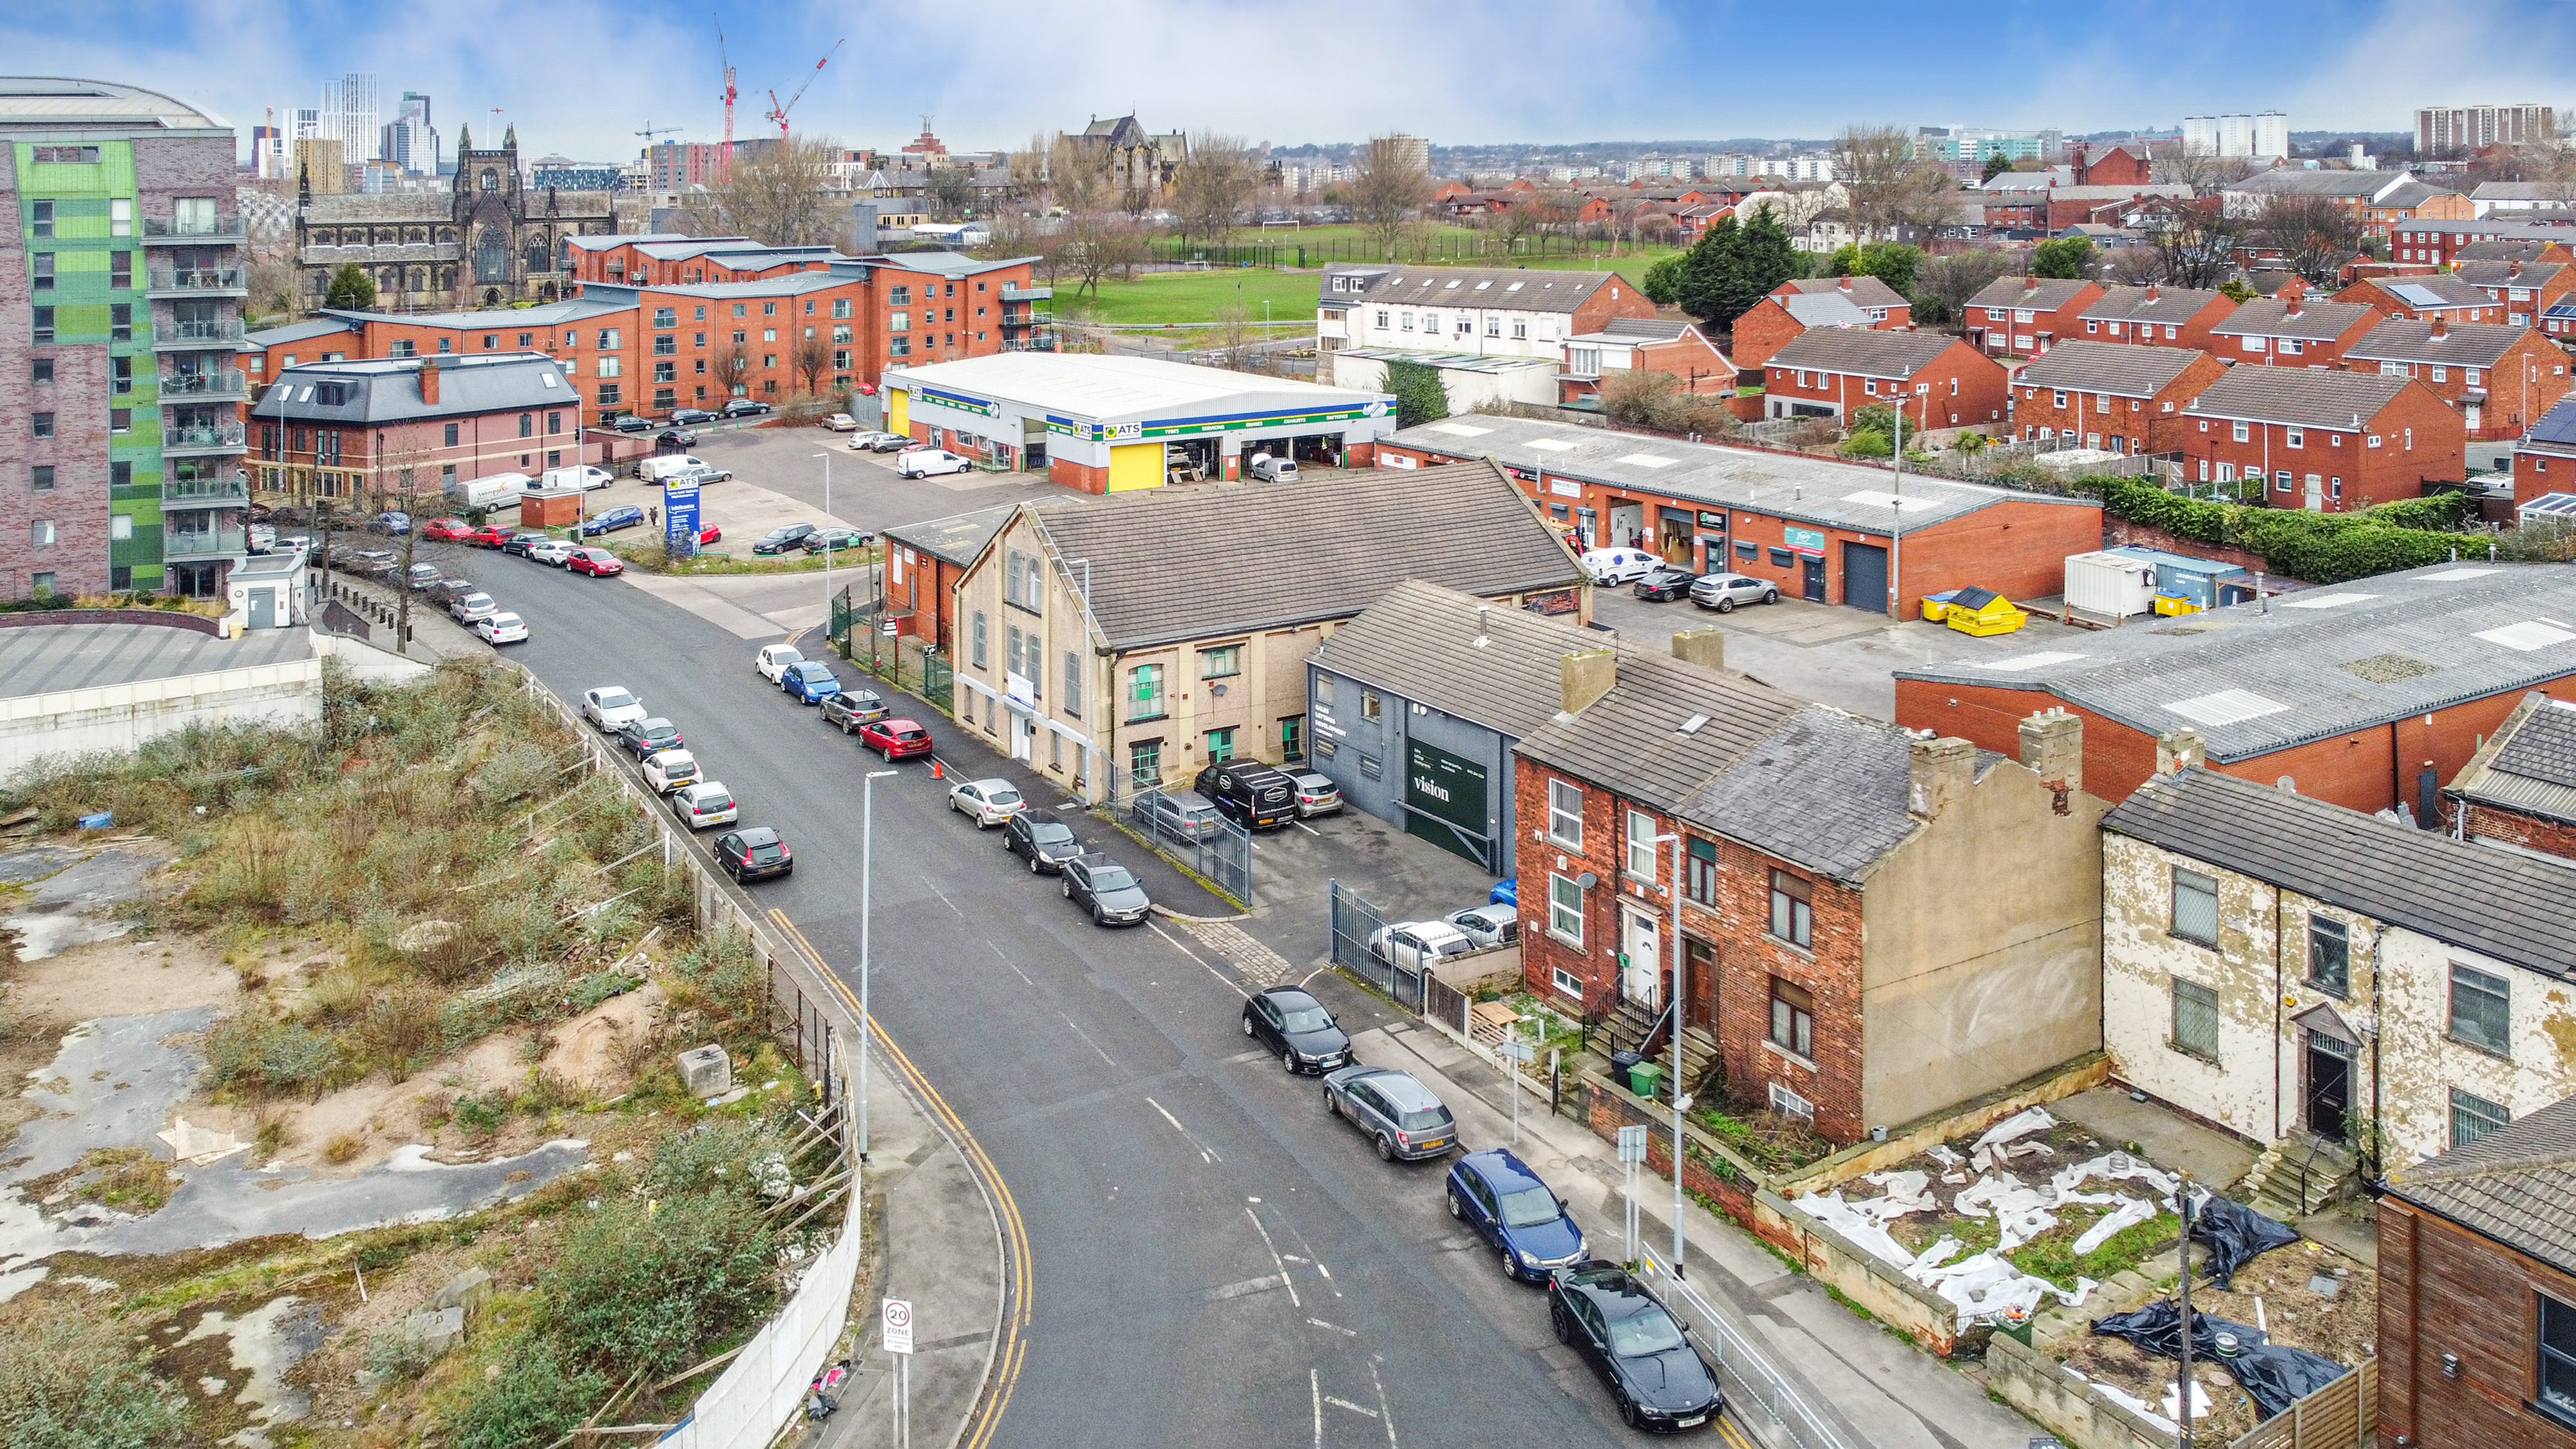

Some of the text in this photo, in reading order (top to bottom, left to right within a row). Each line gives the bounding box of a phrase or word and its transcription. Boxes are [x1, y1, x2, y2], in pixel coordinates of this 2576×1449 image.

[1080, 425, 1091, 434] ATS
[1118, 424, 1140, 434] ATS
[1315, 705, 1329, 714] SALES
[1315, 712, 1336, 724] LETTINGS
[1315, 719, 1347, 737] DEVELOPMENT
[1414, 775, 1450, 802] vision
[890, 1309, 907, 1320] 20
[886, 1327, 909, 1336] ZONE
